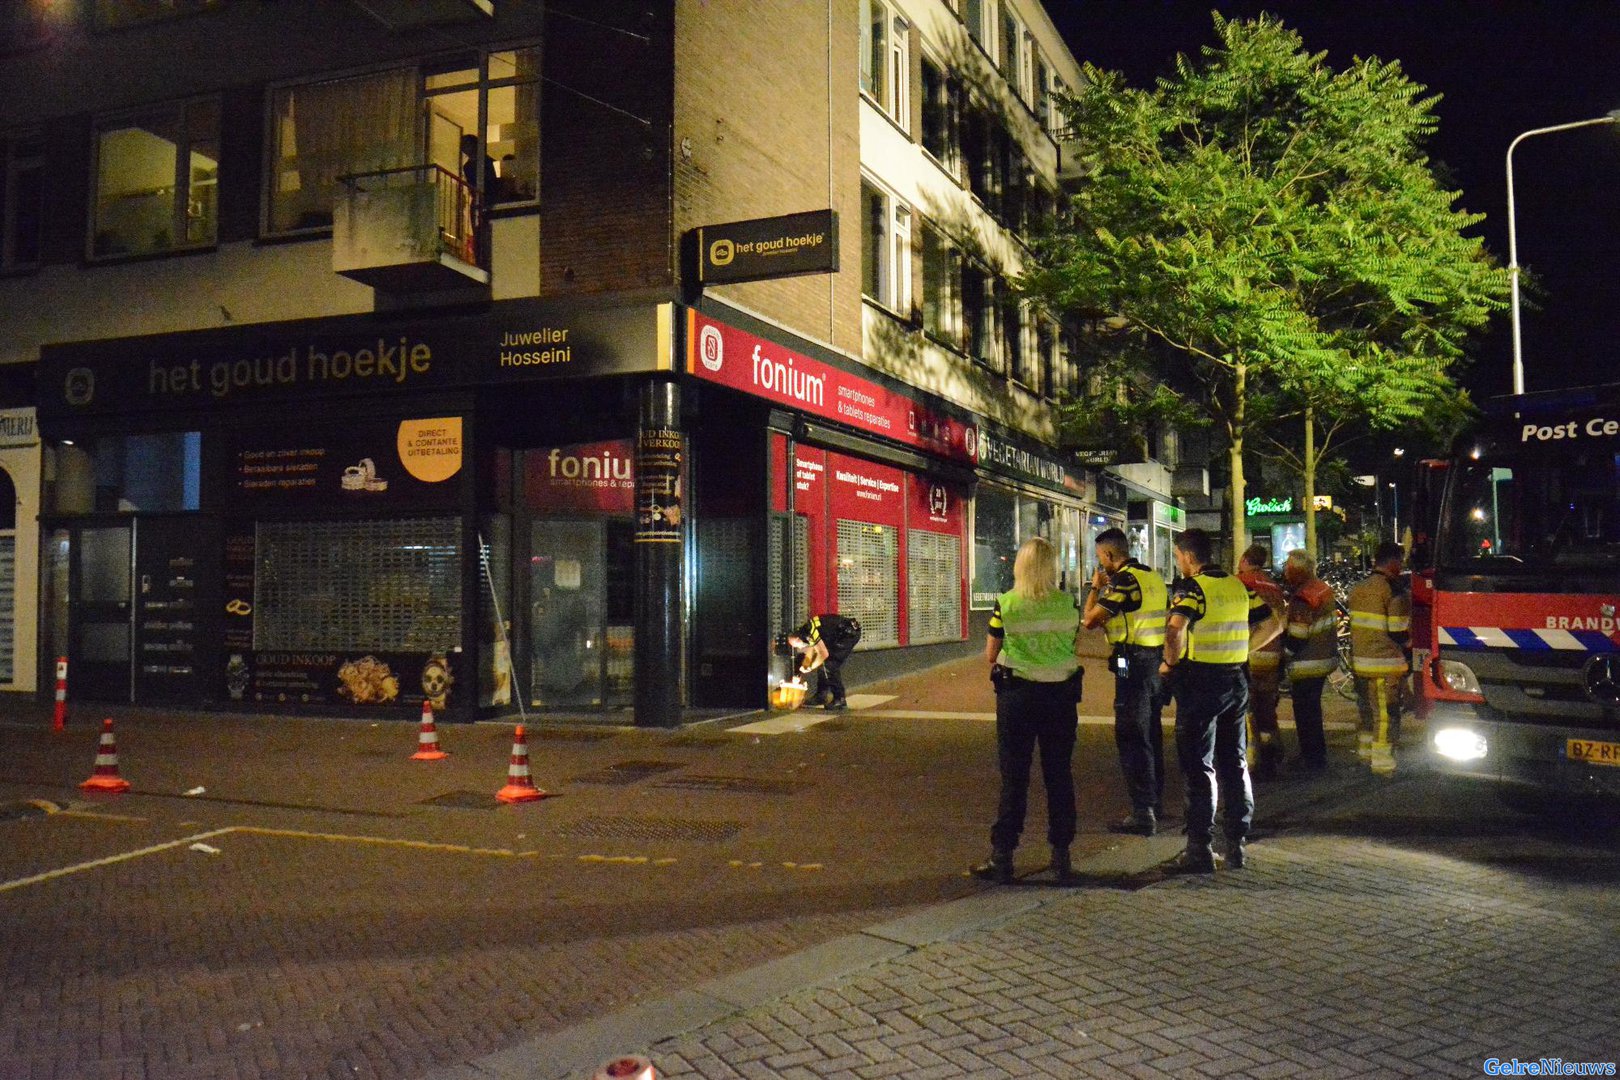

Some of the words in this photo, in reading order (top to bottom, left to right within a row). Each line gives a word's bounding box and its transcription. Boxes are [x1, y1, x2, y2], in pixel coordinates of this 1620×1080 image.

[736, 241, 755, 254] het
[756, 237, 784, 254] goud
[786, 233, 824, 248] hoekje
[500, 328, 569, 347] Juwelier
[500, 346, 571, 367] Hosseini
[149, 358, 201, 395] het
[210, 347, 296, 399] goud
[307, 337, 431, 384] hoekje
[752, 344, 824, 407] fonium
[838, 385, 875, 408] smartphones
[838, 401, 844, 414] &
[844, 403, 865, 420] tablets
[864, 412, 891, 430] reparaties
[418, 429, 447, 438] DIRECT
[1521, 421, 1579, 442] Post
[408, 447, 460, 457] UITBETALING
[415, 438, 458, 447] CONTANTE
[986, 436, 1040, 477] VEGETARIAN
[1040, 458, 1065, 484] WORLD
[860, 475, 877, 488] Service
[1546, 616, 1620, 631] BRAND
